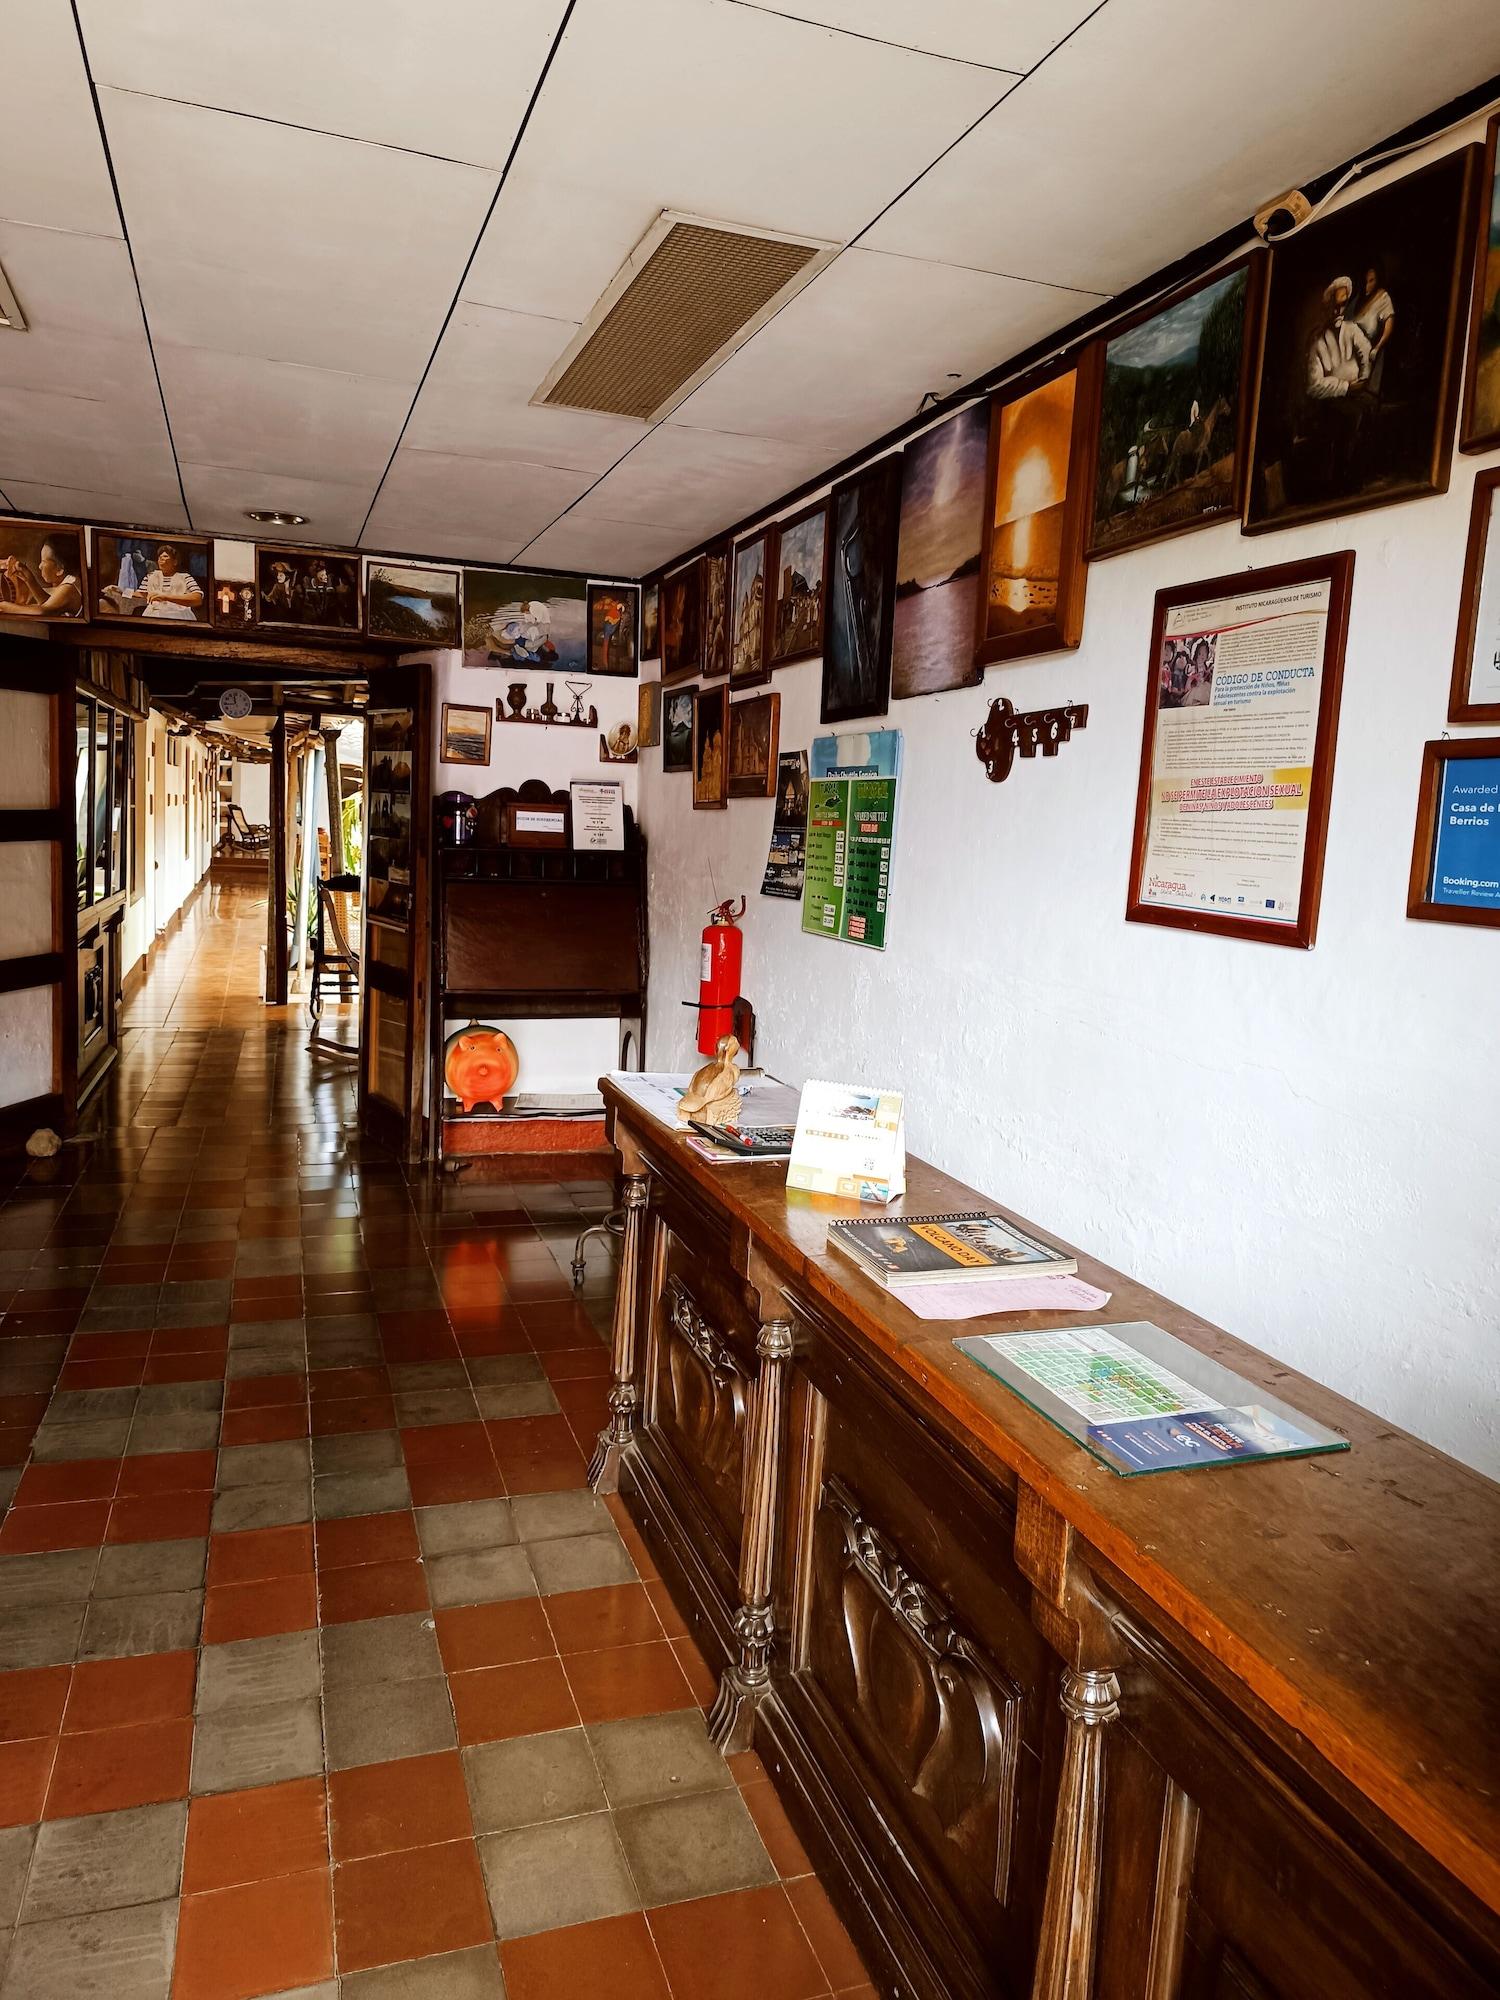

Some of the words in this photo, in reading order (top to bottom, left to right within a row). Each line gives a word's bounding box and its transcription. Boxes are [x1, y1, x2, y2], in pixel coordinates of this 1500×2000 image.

[1235, 602, 1258, 611] INSTITUTO
[1300, 591, 1322, 600] TURISMO
[1251, 672, 1264, 682] DE
[1266, 667, 1315, 681] CONDUCTA
[1269, 783, 1302, 796] SEXUAL
[1452, 785, 1498, 794] Awarded
[1451, 803, 1477, 812] Casa
[1480, 803, 1494, 812] de
[1450, 816, 1489, 826] Berrios
[1148, 876, 1186, 892] Nicaragua
[1443, 876, 1499, 888] Booking.com
[1443, 887, 1470, 895] Traveller
[920, 1225, 962, 1251] VOLCANO
[957, 1250, 984, 1264] DAY
